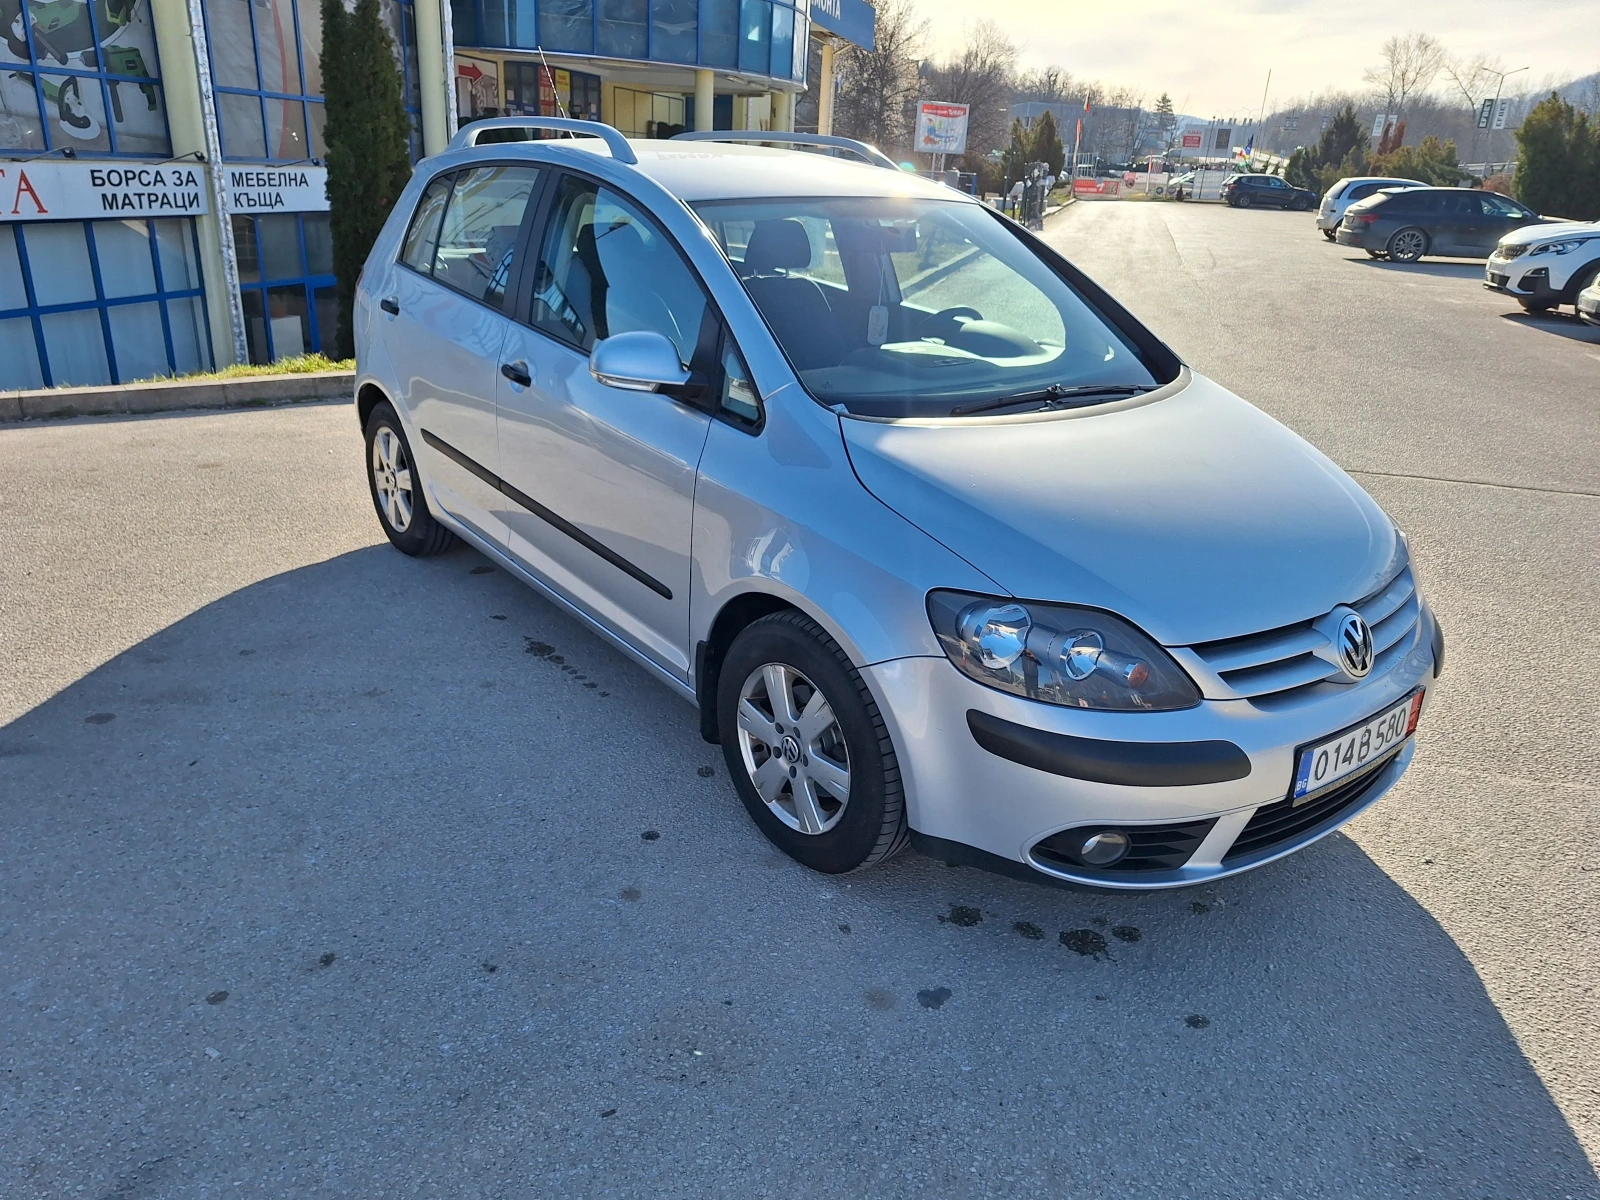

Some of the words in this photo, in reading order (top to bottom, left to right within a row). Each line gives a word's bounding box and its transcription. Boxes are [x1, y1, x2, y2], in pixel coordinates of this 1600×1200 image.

[90, 169, 167, 187] БОРСА
[172, 170, 198, 187] ЗА
[231, 172, 309, 187] МЕБЕЛНА
[101, 192, 200, 211] МАТРАЦИ
[233, 192, 285, 209] КЪЩА
[1296, 778, 1308, 792] BG
